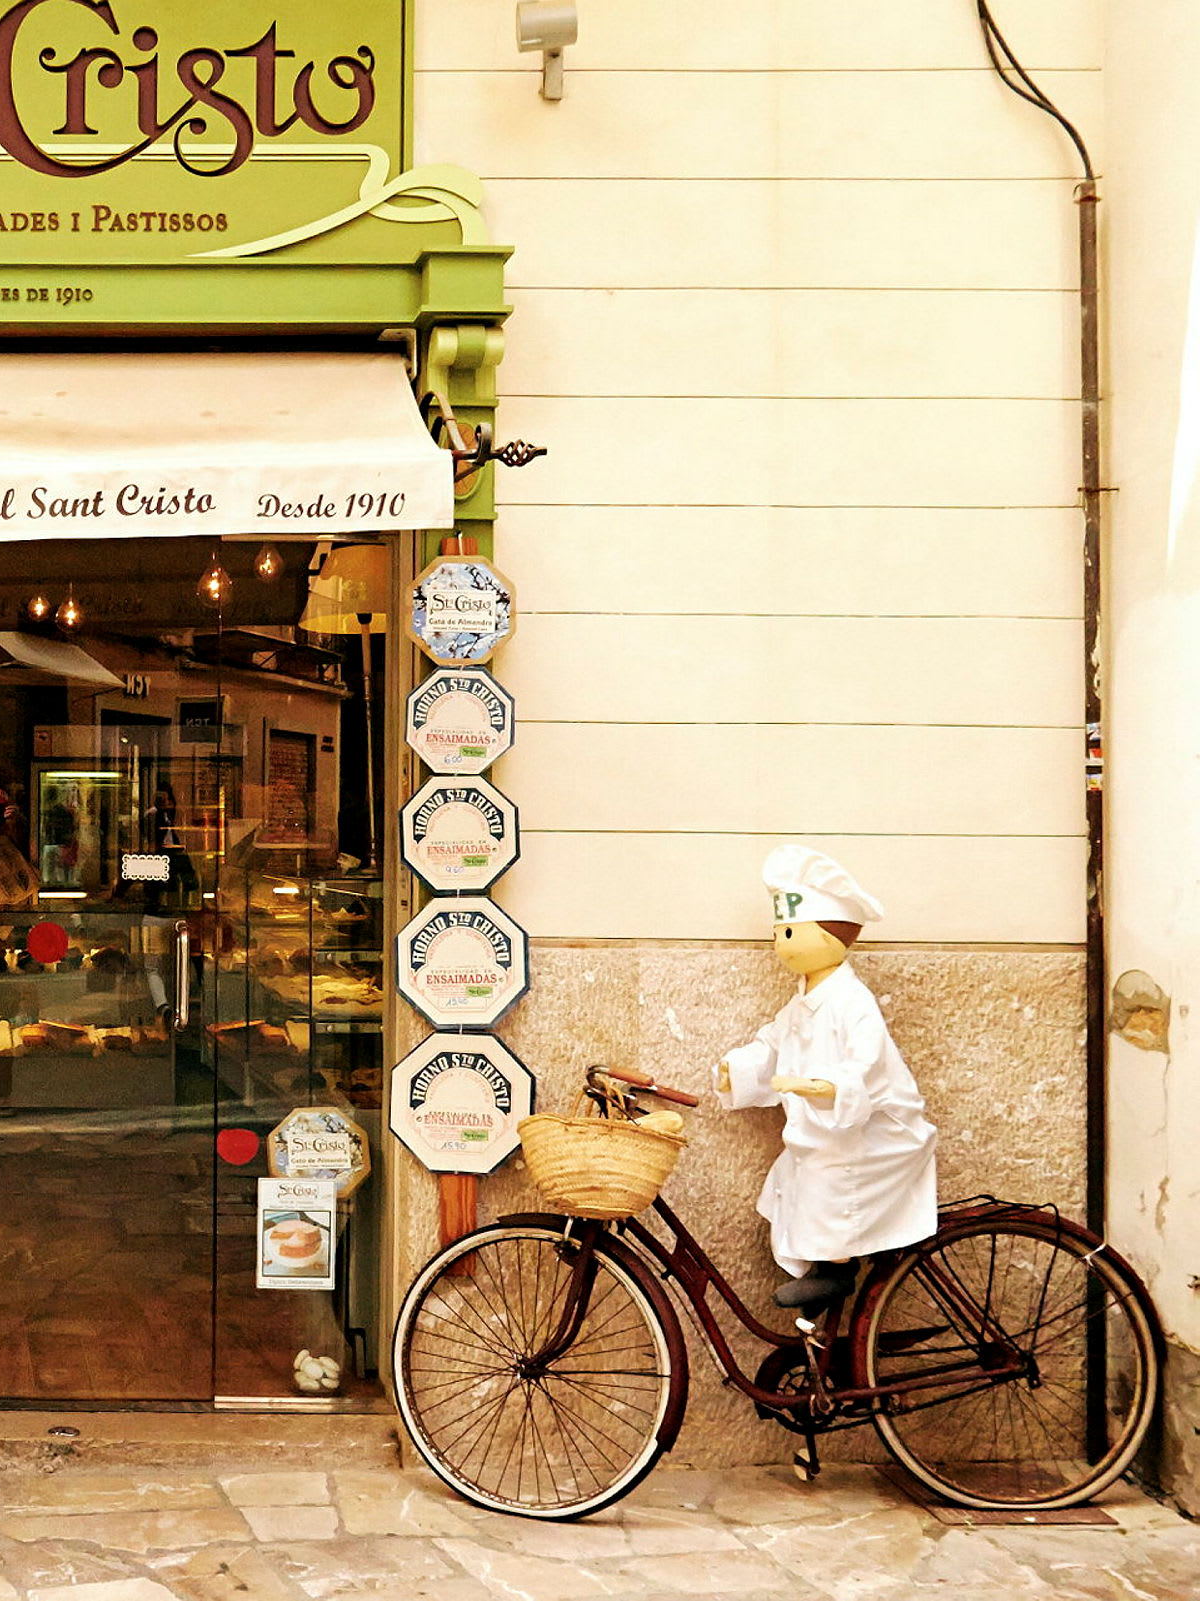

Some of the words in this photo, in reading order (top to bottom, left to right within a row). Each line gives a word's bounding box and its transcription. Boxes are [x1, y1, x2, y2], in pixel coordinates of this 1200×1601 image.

[91, 204, 229, 233] PASTISSOS
[27, 287, 50, 304] DE
[53, 287, 94, 307] 1910
[26, 486, 106, 520] Sant
[114, 483, 217, 517] Cristo
[256, 492, 338, 520] Desde
[345, 491, 406, 519] 1910
[414, 681, 448, 722] HORNO
[471, 682, 504, 725] CRISTO
[426, 733, 491, 745] ENSAIMADAS
[414, 793, 445, 835] HORNO
[468, 792, 503, 834] CRISTO
[426, 844, 491, 855] ENSAIMADAS
[412, 917, 448, 963] HORNO
[473, 916, 510, 962] CRISTO
[426, 973, 498, 985] ENSAIMADAS
[412, 1056, 450, 1101] HORNO
[475, 1058, 510, 1107] CRISTO
[423, 1114, 494, 1128] ENSAIMADAS
